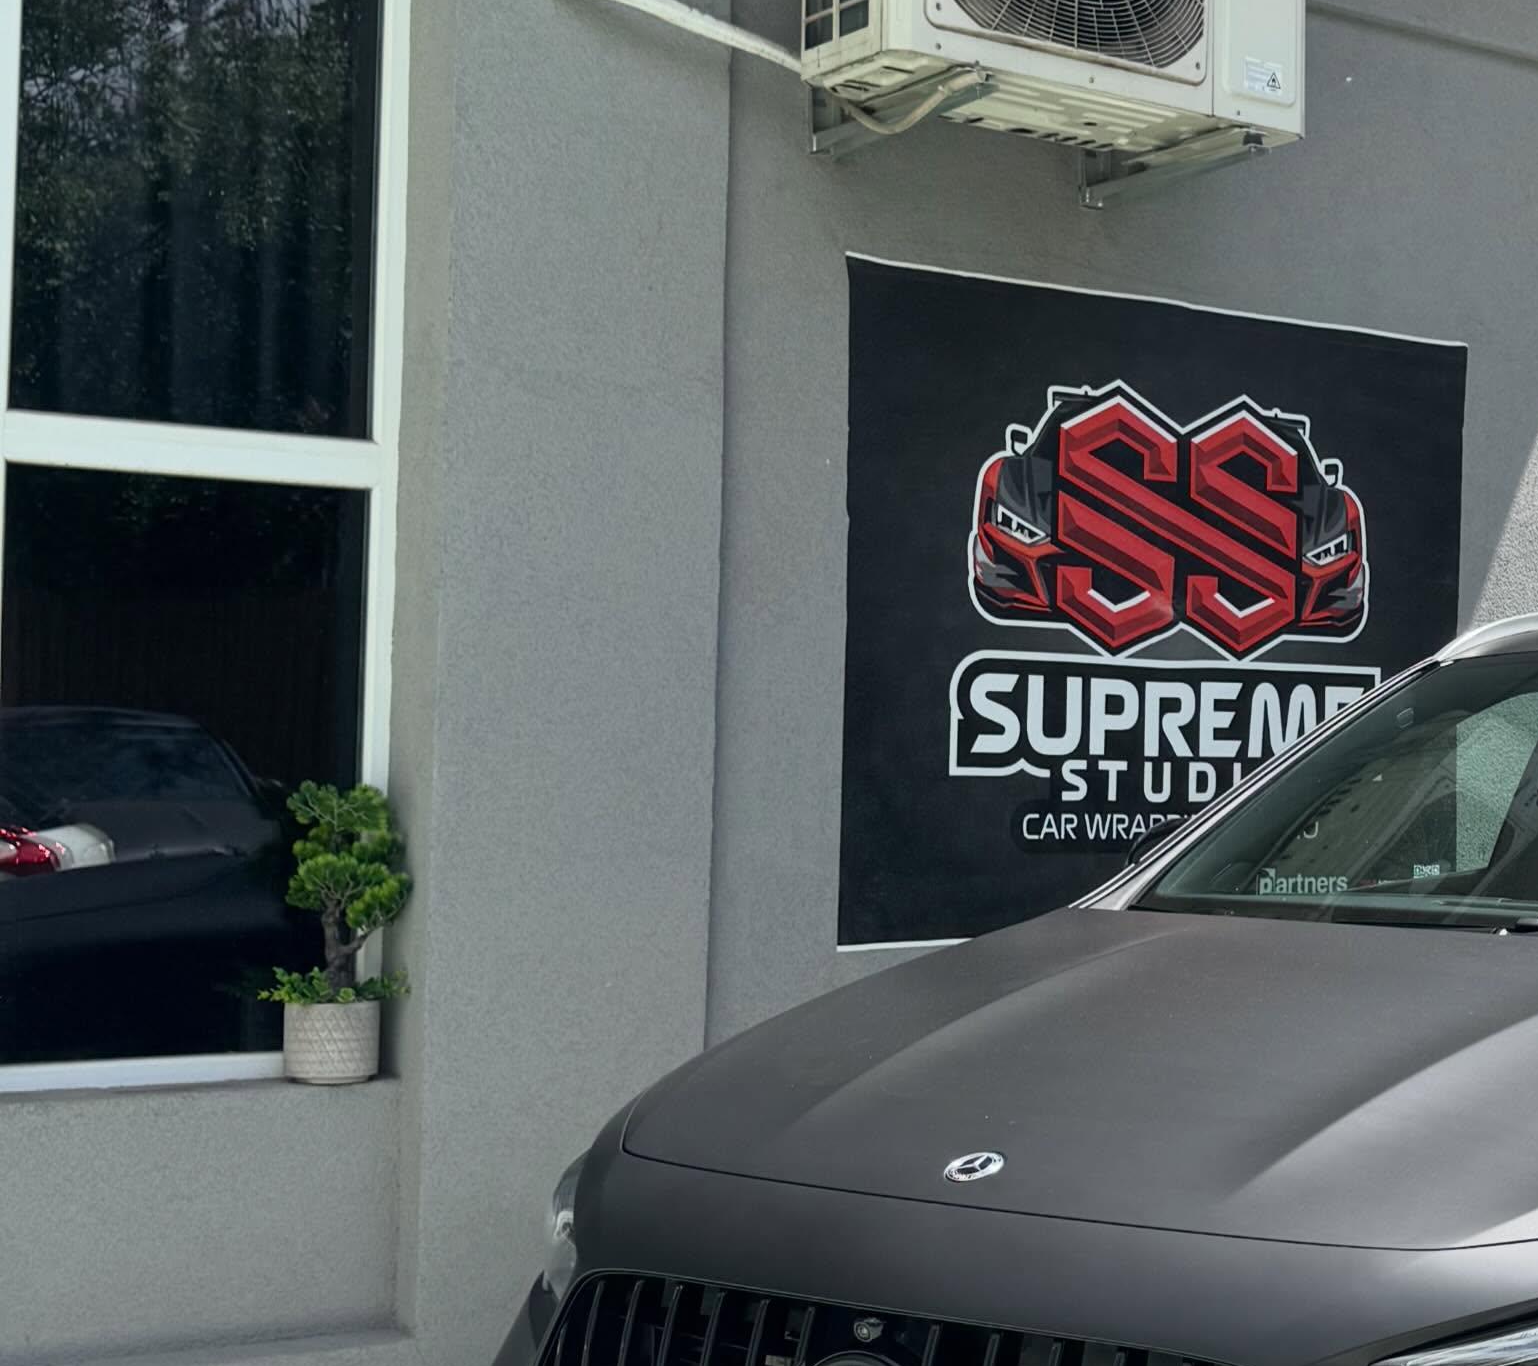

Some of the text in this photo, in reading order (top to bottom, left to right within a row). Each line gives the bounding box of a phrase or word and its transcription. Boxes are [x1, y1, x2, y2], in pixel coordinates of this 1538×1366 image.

[1061, 760, 1242, 803] STUDI
[1022, 813, 1077, 840] CAR
[1258, 873, 1348, 895] partners
